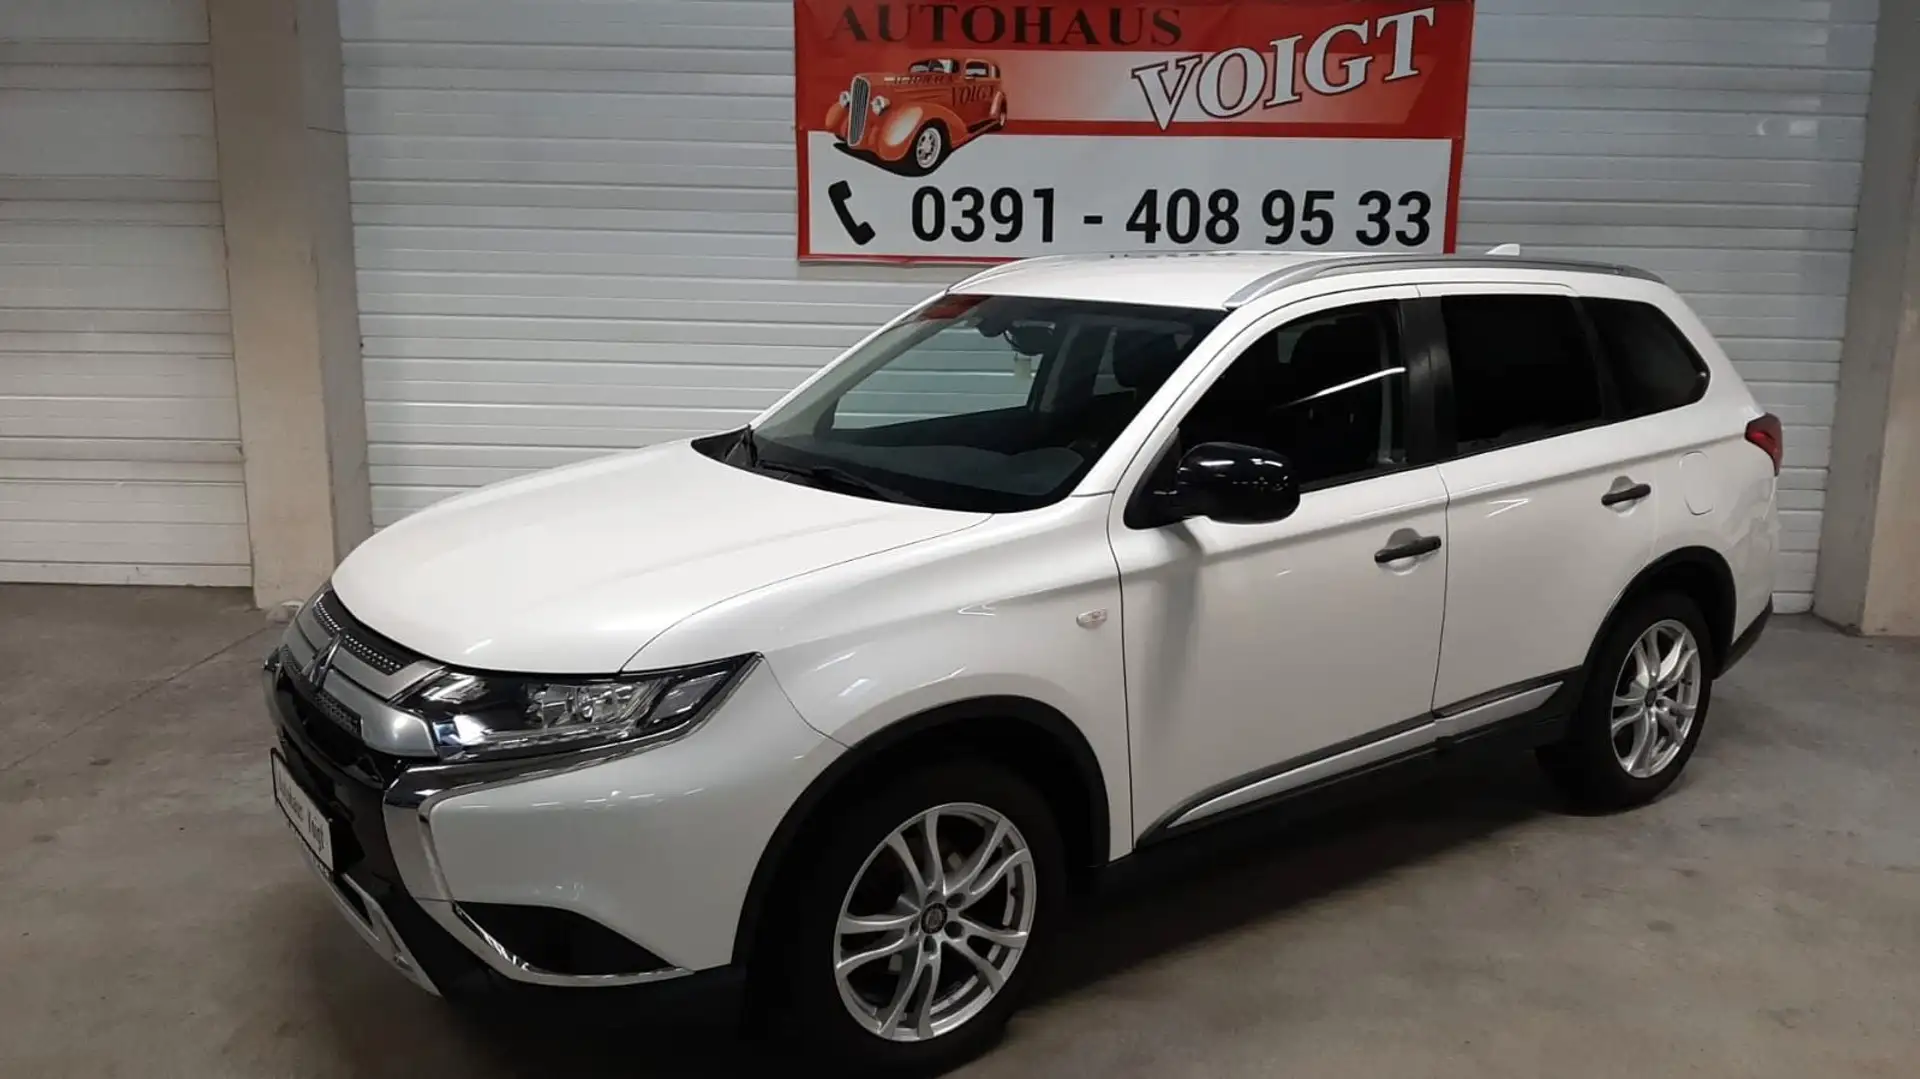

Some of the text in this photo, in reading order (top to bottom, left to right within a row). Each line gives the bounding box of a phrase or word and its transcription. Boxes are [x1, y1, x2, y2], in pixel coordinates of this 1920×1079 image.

[827, 4, 1182, 46] AUTOHAUS
[1131, 6, 1435, 131] VOIGT
[912, 186, 1431, 247] 0391 - 408 95 33
